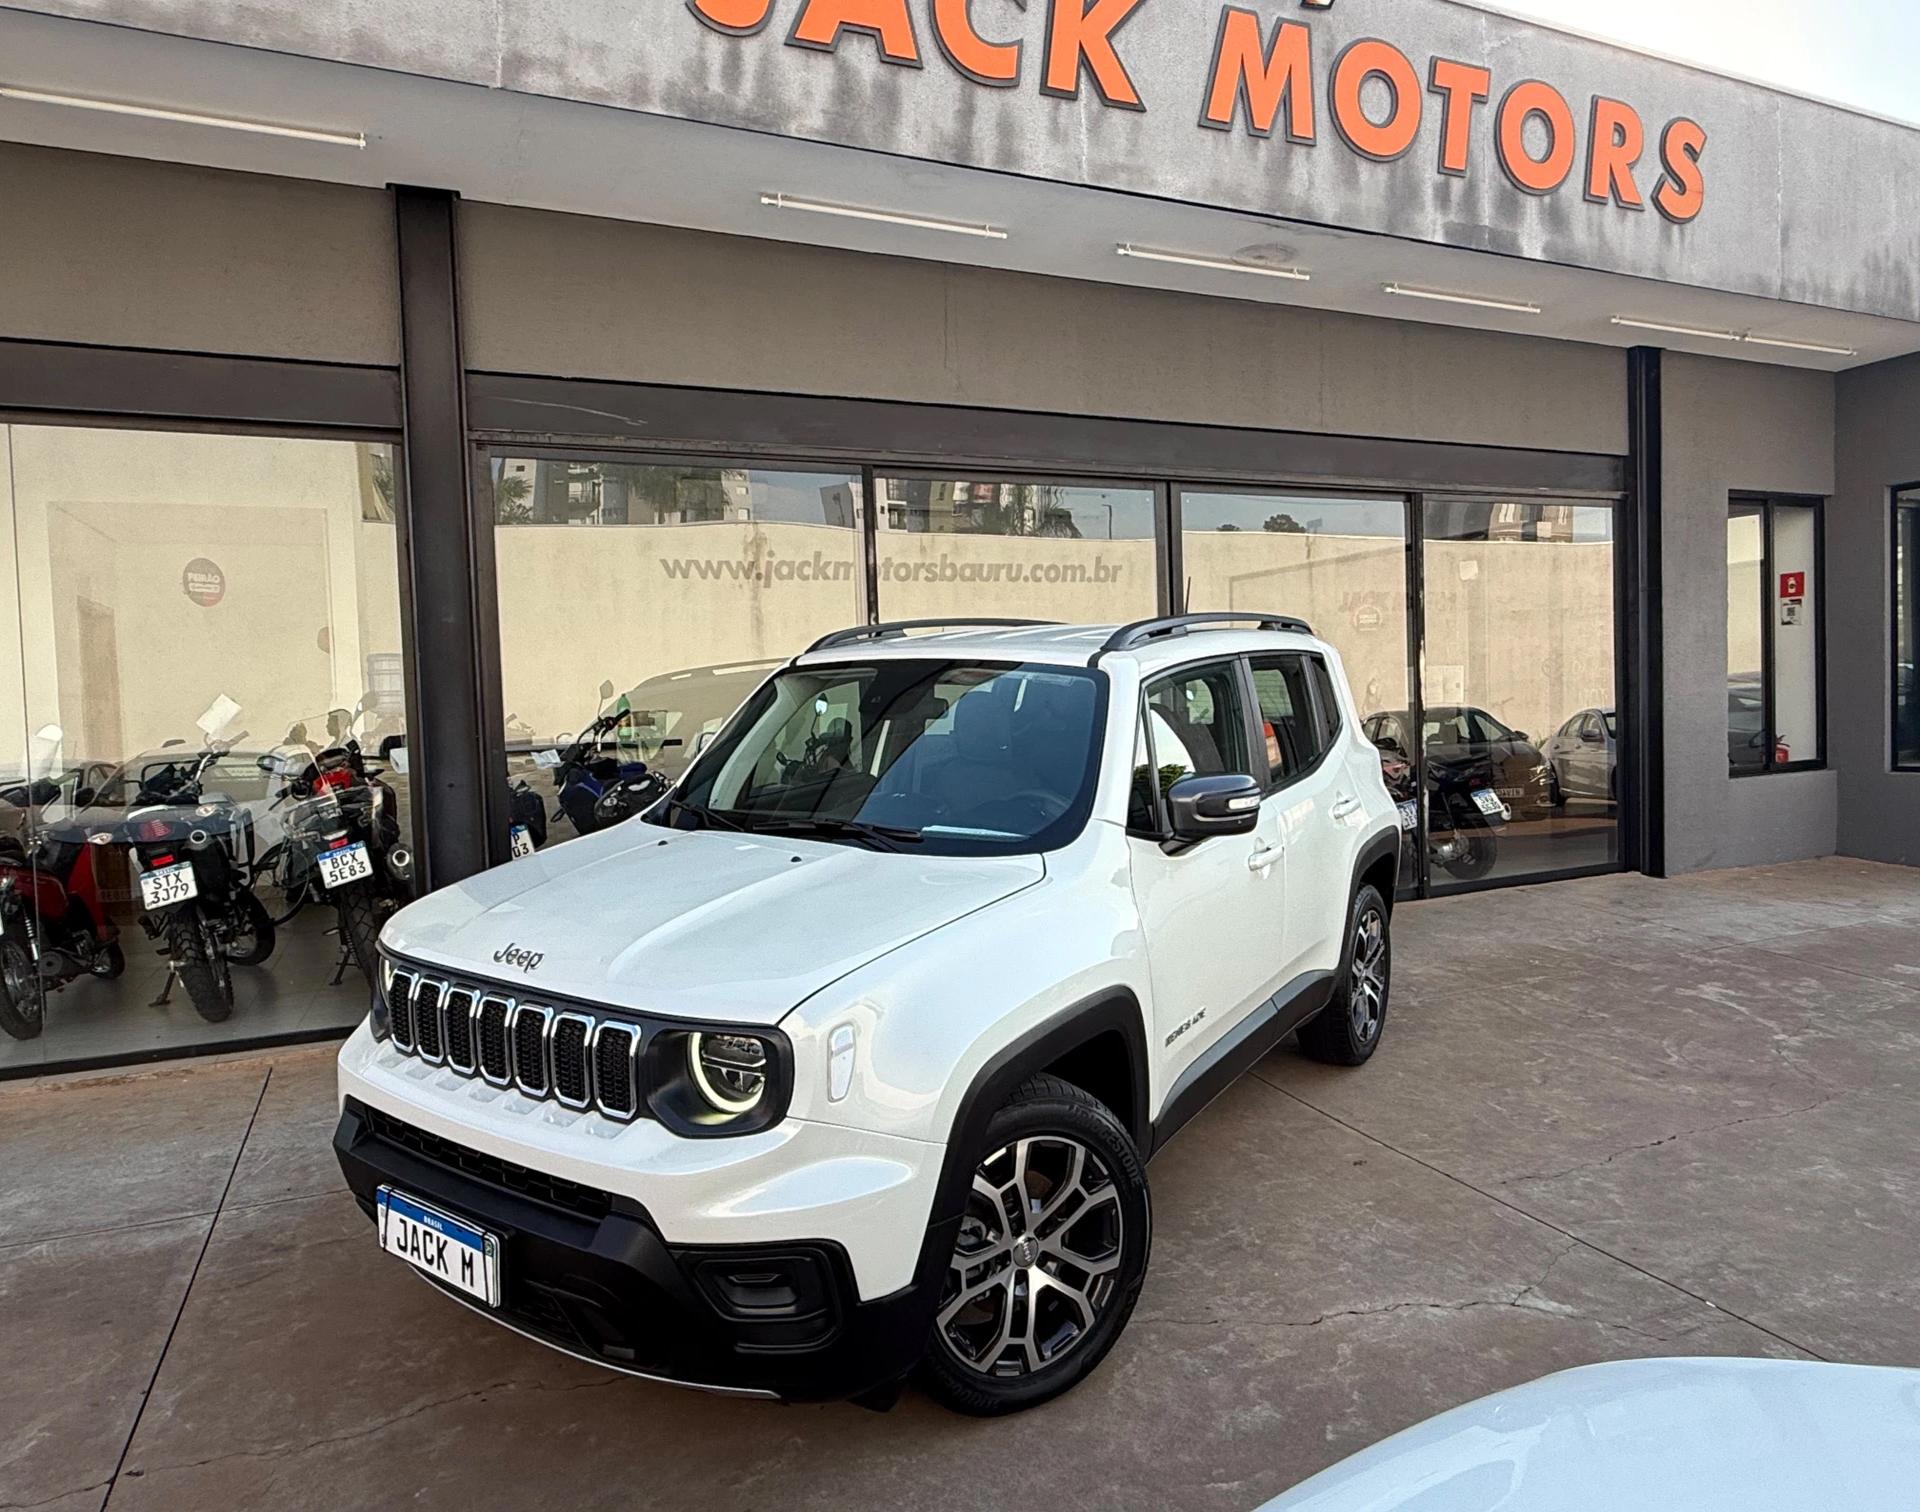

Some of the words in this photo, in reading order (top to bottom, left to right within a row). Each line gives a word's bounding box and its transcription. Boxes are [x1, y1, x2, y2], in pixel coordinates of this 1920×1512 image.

[1199, 3, 1708, 225] MOTORS
[330, 851, 359, 870] BCX
[153, 872, 183, 890] STX
[329, 861, 367, 883] 5E83
[150, 883, 190, 905] 3J79
[493, 942, 545, 974] Jeep
[423, 1214, 444, 1232] BRASIL
[396, 1217, 449, 1275] JACK
[461, 1246, 475, 1289] M
